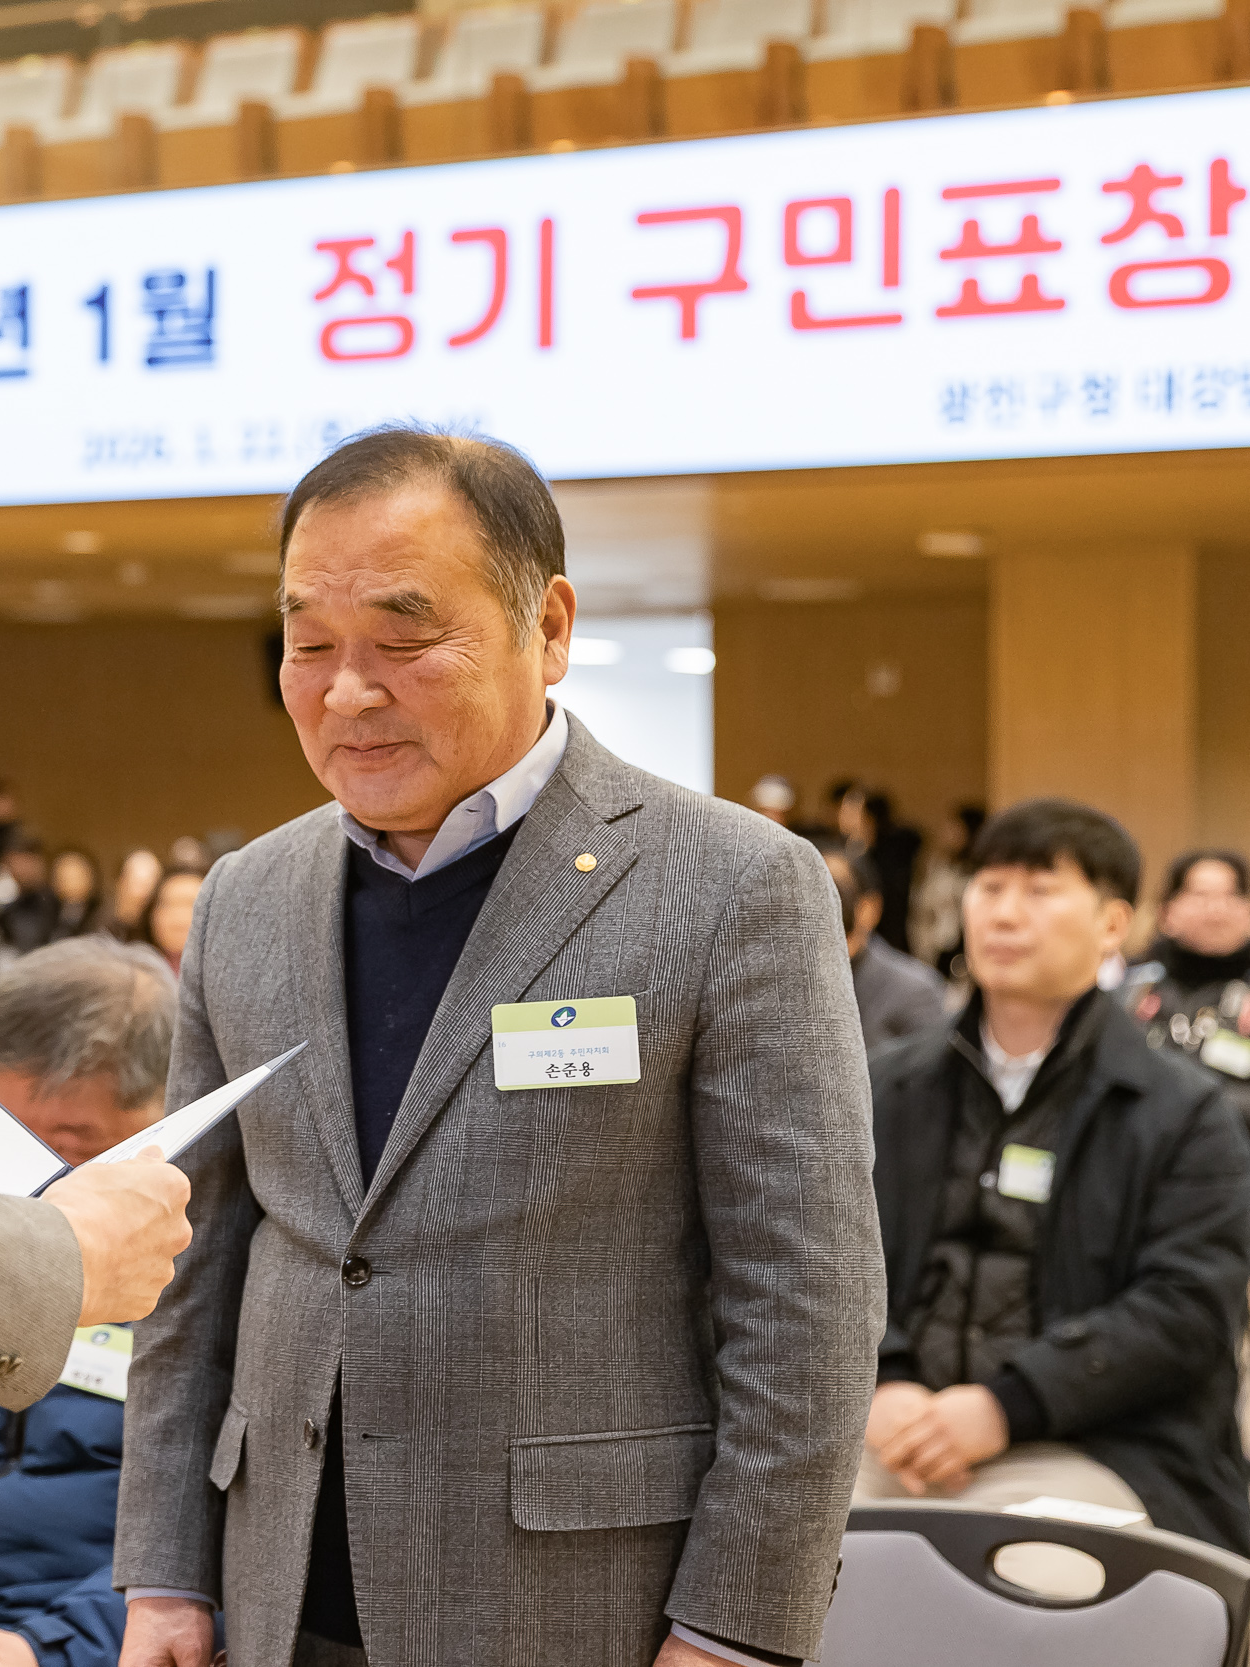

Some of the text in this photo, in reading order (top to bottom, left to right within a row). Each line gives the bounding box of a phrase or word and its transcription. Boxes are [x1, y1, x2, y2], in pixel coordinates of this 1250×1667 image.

[83, 268, 217, 369] 1월
[313, 217, 554, 362] 정기
[630, 157, 1247, 341] 구민표창
[528, 1047, 609, 1058] 구의제2동 주민자치회
[545, 1061, 594, 1078] 손준용
